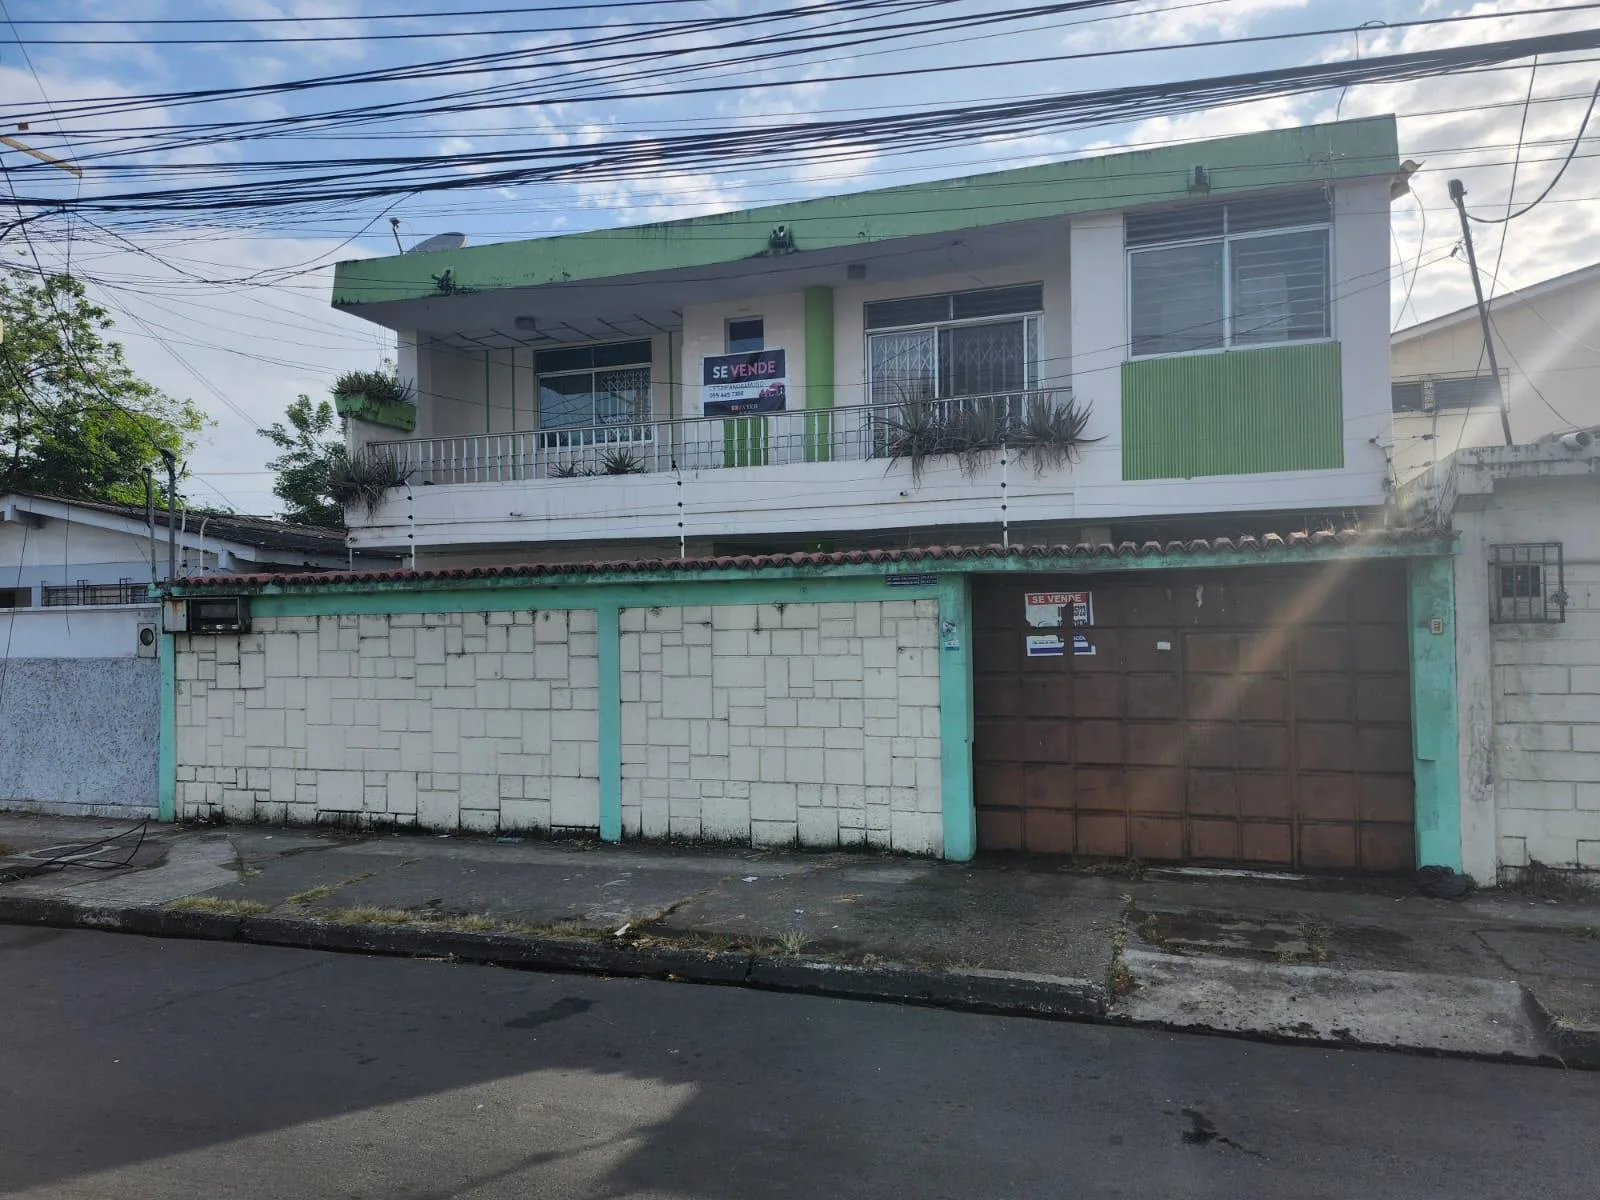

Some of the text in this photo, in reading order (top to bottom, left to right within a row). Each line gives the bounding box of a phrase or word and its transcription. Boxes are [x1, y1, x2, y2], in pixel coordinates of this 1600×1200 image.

[712, 360, 776, 379] SE VENDE
[1032, 594, 1082, 604] SE VENDE
